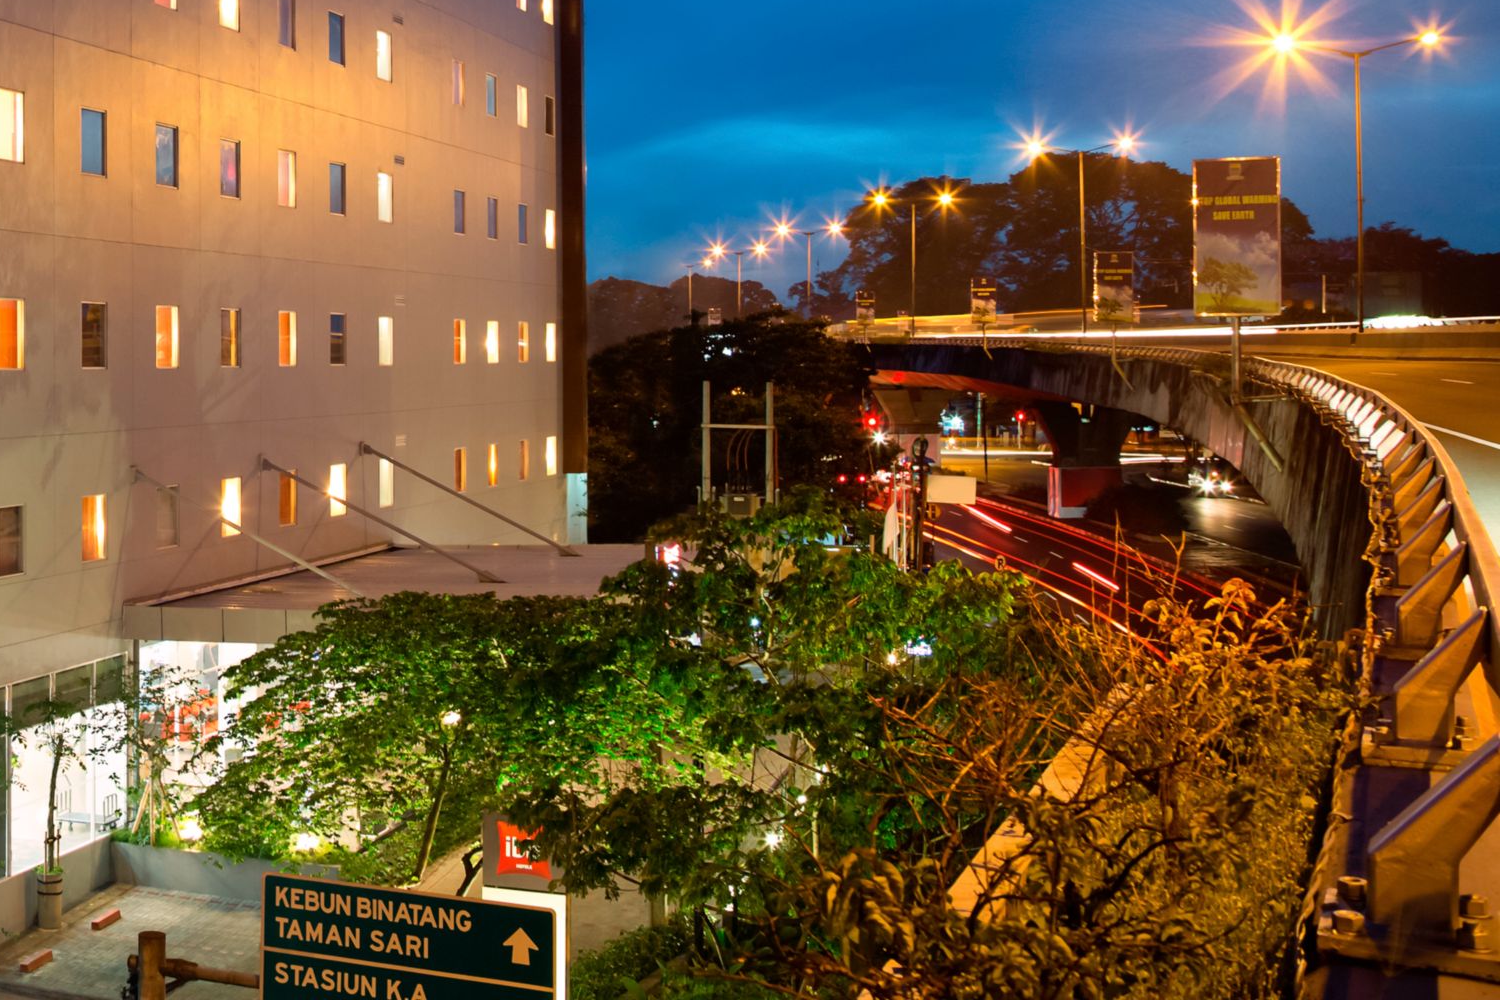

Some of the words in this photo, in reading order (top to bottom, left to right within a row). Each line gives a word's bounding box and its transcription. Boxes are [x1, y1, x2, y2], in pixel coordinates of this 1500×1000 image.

[275, 886, 350, 916] KEBUN
[356, 896, 472, 932] BINATANG
[275, 917, 361, 949] TAMAN
[370, 930, 429, 959] SARI
[274, 962, 377, 999] STASIUN
